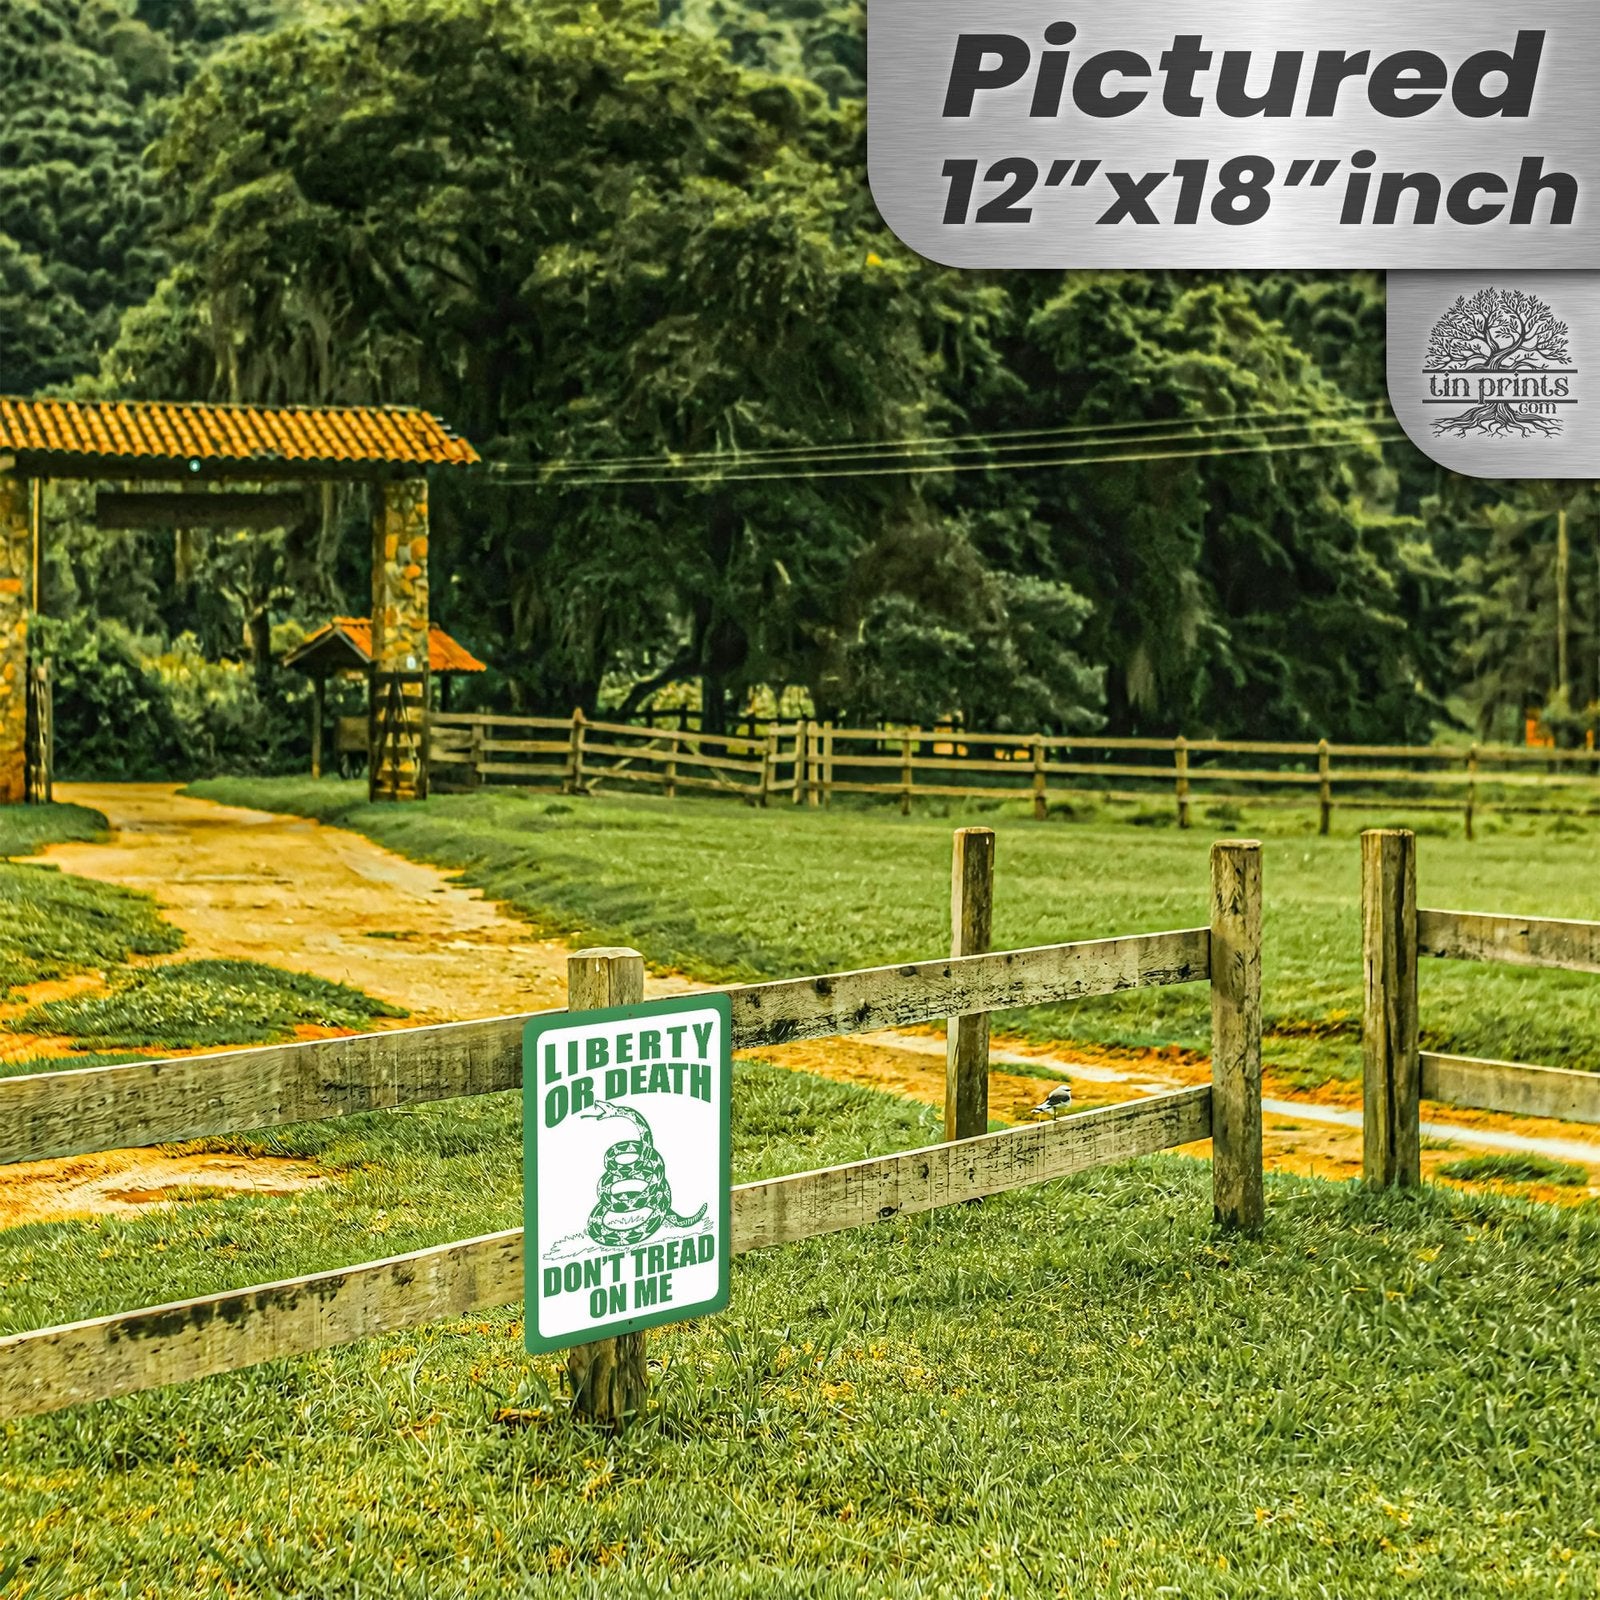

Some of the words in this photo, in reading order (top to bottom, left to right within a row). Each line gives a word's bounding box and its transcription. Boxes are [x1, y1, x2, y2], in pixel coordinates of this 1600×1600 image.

[545, 1021, 714, 1085] LIBERTY
[545, 1076, 595, 1128] OR
[605, 1063, 711, 1103] DEATH
[544, 1252, 625, 1298] DON'T
[631, 1234, 715, 1278] TREAD
[590, 1283, 627, 1318] ON
[634, 1273, 673, 1310] ME
